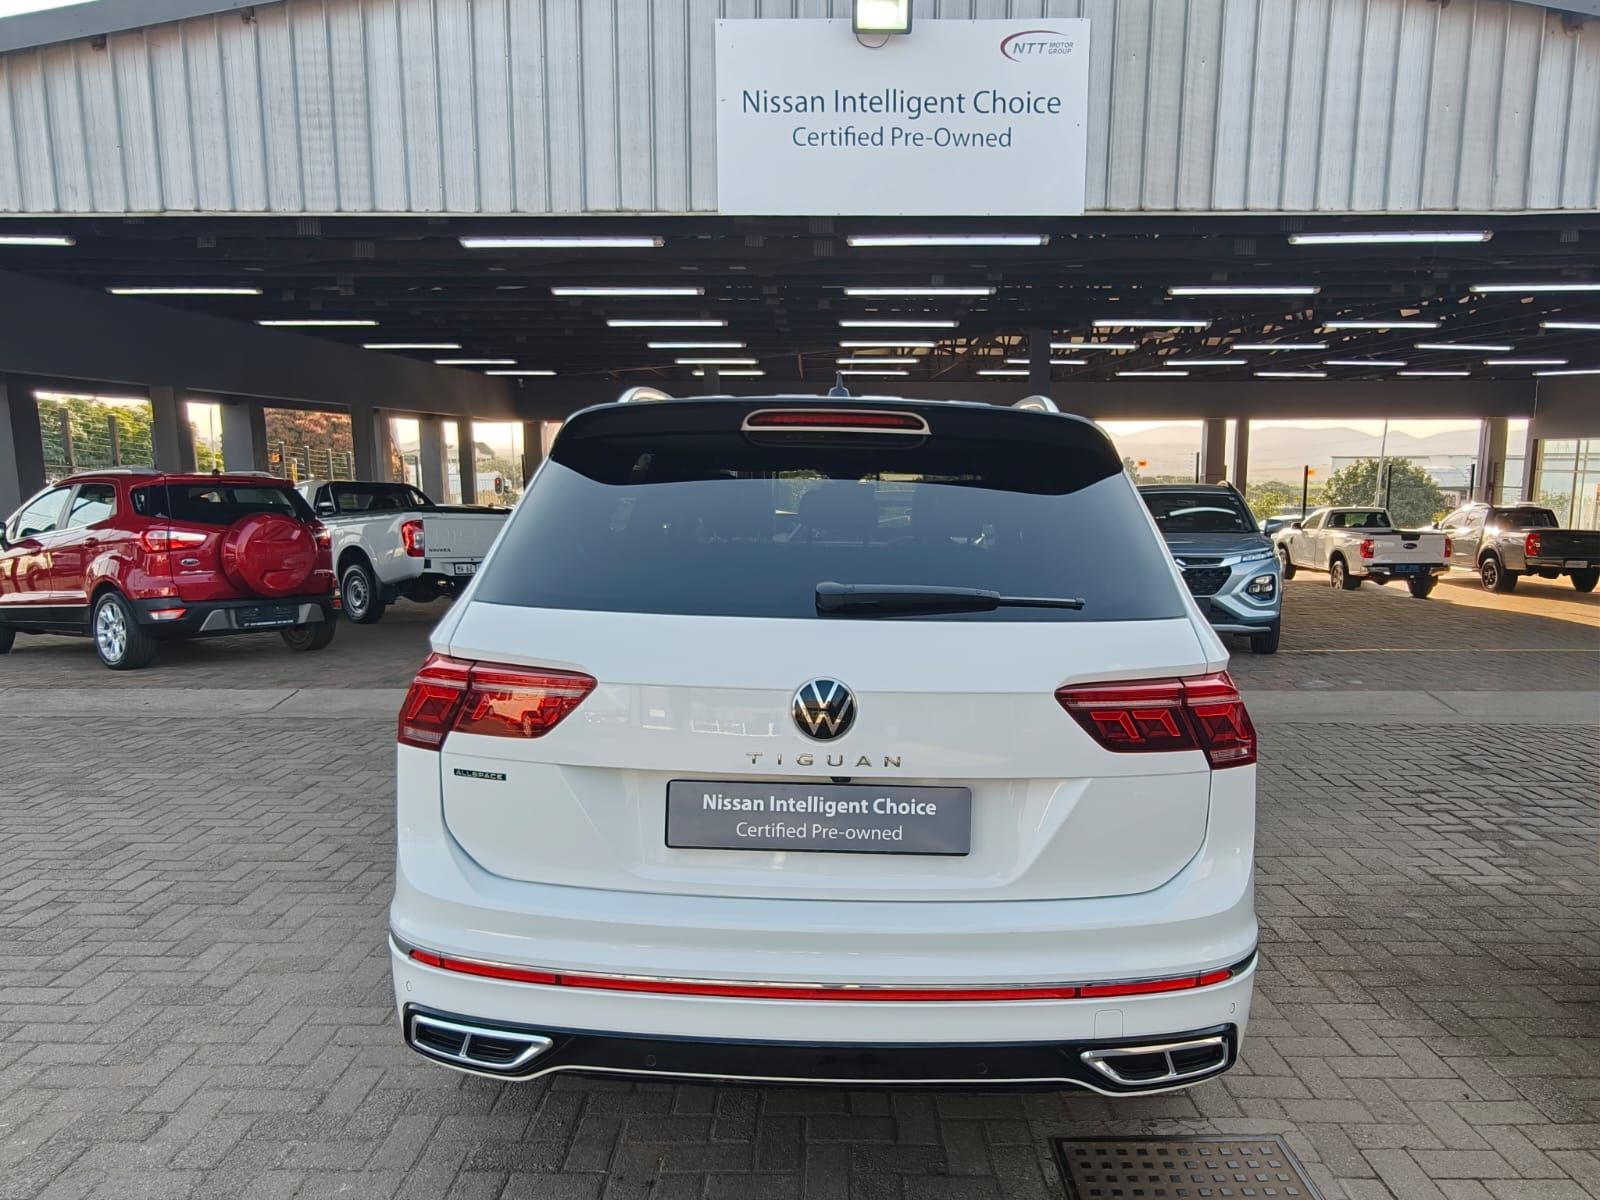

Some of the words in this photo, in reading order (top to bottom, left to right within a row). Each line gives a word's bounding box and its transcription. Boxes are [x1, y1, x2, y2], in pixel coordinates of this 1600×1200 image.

[1012, 42, 1048, 54] NTT
[742, 89, 825, 113] Nissan
[834, 88, 965, 120] Intelligent
[972, 89, 1062, 115] Choice
[792, 126, 884, 147] Certified
[890, 127, 1012, 148] Pre-Owned
[745, 752, 902, 768] TIGUAN
[455, 769, 504, 781] ALLSPACE
[703, 794, 765, 812] Nissan
[770, 796, 868, 817] Intelligent
[873, 797, 937, 816] Choice
[736, 822, 807, 839] Certified
[812, 824, 903, 841] Pre-owned
